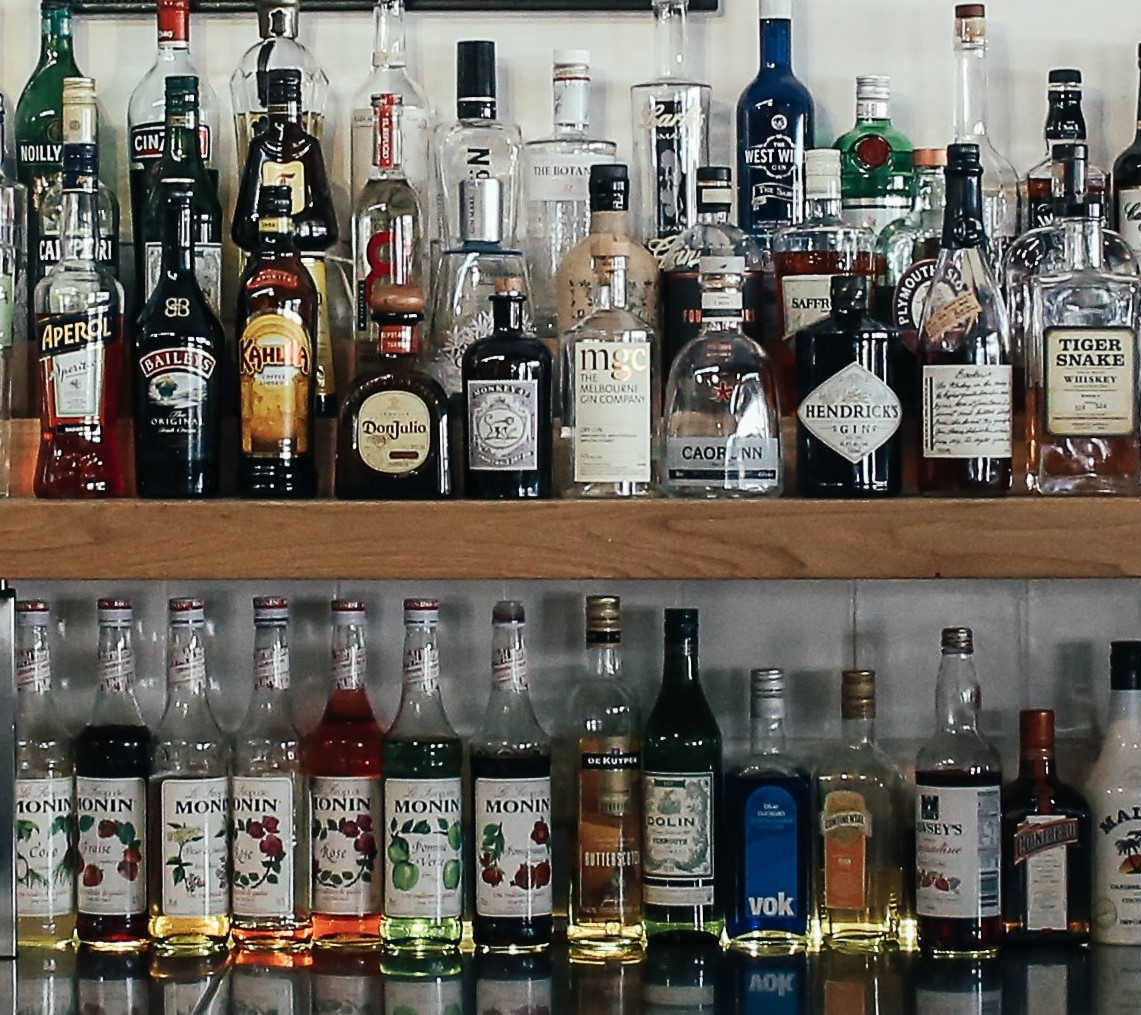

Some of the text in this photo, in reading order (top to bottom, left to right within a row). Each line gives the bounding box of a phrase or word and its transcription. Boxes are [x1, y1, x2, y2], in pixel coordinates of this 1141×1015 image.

[20, 144, 63, 162] NOILLY
[744, 149, 774, 164] WEST
[553, 165, 592, 176] BOTAN
[791, 297, 831, 310] SAFFR
[42, 317, 112, 351] APEROL
[1058, 338, 1122, 352] TIGER
[145, 350, 215, 375] BAILEYS
[580, 346, 648, 381] mgc
[1056, 353, 1125, 367] SNAKE
[580, 373, 598, 383] THE
[1063, 375, 1118, 384] WHISKEY
[580, 384, 639, 394] MELBOURNE
[580, 395, 646, 404] GIN COMPANY
[806, 404, 899, 419] HENDRICK'S
[839, 424, 871, 434] GIN
[394, 800, 460, 814] MONIN
[485, 798, 551, 813] MONIN
[748, 892, 796, 917] vok
